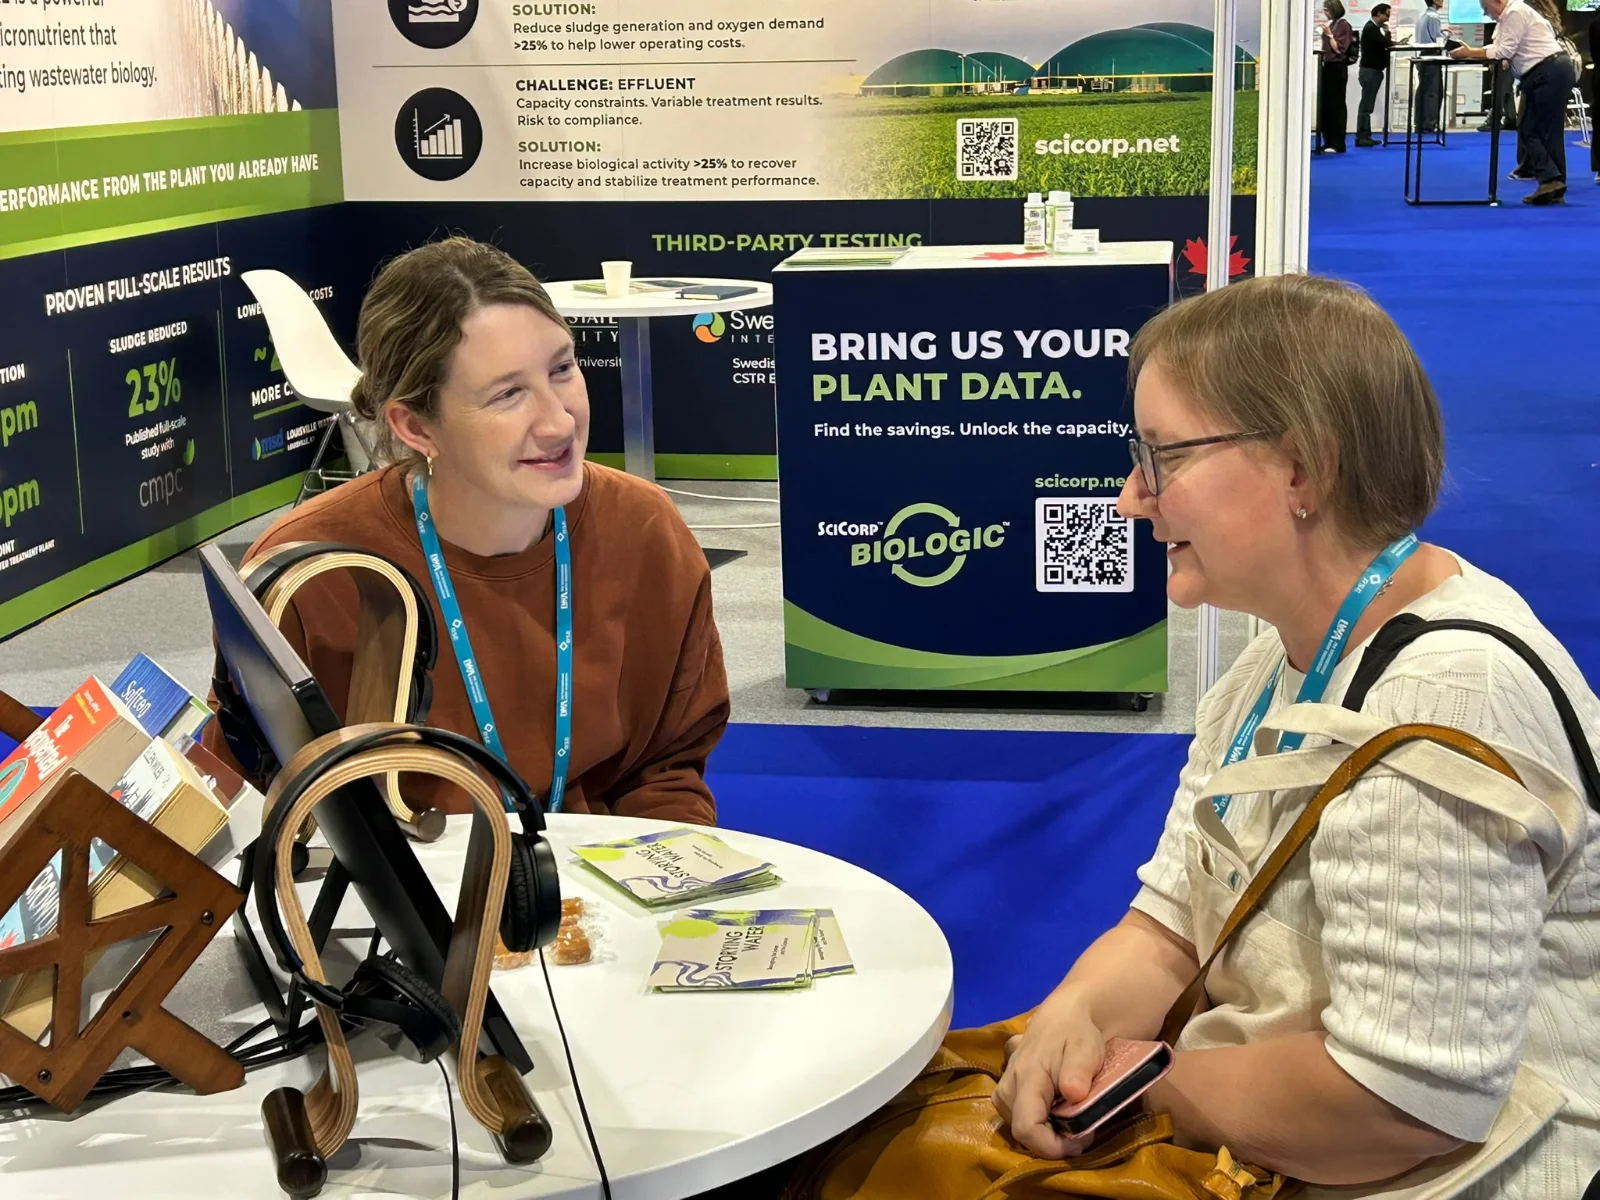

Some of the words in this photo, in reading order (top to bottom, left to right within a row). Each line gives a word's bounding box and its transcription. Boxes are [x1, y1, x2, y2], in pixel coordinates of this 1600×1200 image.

[512, 3, 596, 16] SOLUTION:
[89, 23, 117, 46] that
[513, 22, 562, 34] Reduce
[565, 22, 609, 35] sludge
[612, 20, 684, 35] generation
[688, 19, 713, 31] and
[716, 19, 765, 34] oxygen
[768, 18, 825, 30] demand
[513, 39, 548, 51] >25%
[551, 41, 564, 51] to
[567, 39, 596, 52] help
[599, 38, 636, 50] lower
[639, 38, 703, 52] operating
[707, 37, 745, 49] costs.
[29, 65, 107, 87] wastewater
[111, 61, 157, 88] biology.
[515, 79, 613, 92] CHALLENGE:
[617, 78, 696, 91] EFFLUENT
[516, 97, 571, 111] Capacity
[574, 97, 648, 109] constraints.
[651, 96, 703, 108] Variable
[706, 96, 772, 107] treatment
[775, 94, 823, 106] results.
[517, 114, 544, 126] Risk
[548, 115, 560, 126] to
[564, 114, 643, 127] compliance.
[518, 141, 601, 153] SOLUTION:
[1035, 132, 1180, 158] scicorp.net
[103, 174, 140, 197] FROM
[143, 170, 167, 192] THE
[170, 166, 207, 188] PLANT
[209, 163, 235, 183] YOU
[238, 157, 288, 180] ALREADY
[291, 153, 319, 173] HAVE
[519, 159, 573, 171] Increase
[576, 158, 639, 172] biological
[642, 158, 690, 172] activity
[693, 158, 728, 169] >25%
[731, 158, 744, 169] to
[748, 159, 797, 169] recover
[519, 176, 574, 189] capacity
[577, 175, 602, 187] and
[605, 175, 658, 187] stabilize
[661, 175, 728, 187] treatment
[731, 175, 820, 188] performance.
[652, 233, 814, 251] THIRD-PARTY
[820, 233, 922, 248] TESTING
[45, 284, 105, 316] PROVEN
[108, 269, 181, 302] FULL-SCALE
[182, 256, 231, 282] RESULTS
[237, 302, 263, 319] LOWE
[309, 286, 333, 301] COSTS
[110, 331, 146, 354] SLUDGE
[148, 321, 187, 343] REDUCED
[811, 331, 937, 361] BRING
[951, 330, 1004, 360] US
[1013, 328, 1129, 358] YOUR
[125, 357, 181, 418] 23%
[732, 373, 766, 384] CSTR
[813, 372, 948, 402] PLANT
[961, 371, 1082, 400] DATA.
[252, 383, 281, 407] MORE
[125, 423, 159, 446] Published
[159, 415, 187, 435] full-scale
[814, 423, 850, 437] Find
[855, 423, 883, 437] the
[887, 422, 955, 439] savings.
[960, 422, 1019, 436] Unlock
[1023, 421, 1052, 435] the
[1056, 420, 1133, 437] capacity.
[141, 443, 160, 460] study
[160, 438, 175, 453] with
[139, 467, 183, 507] cmpc
[1035, 473, 1126, 491] scicorp.ne
[741, 925, 765, 952] WATER
[715, 931, 743, 971] STORYING
